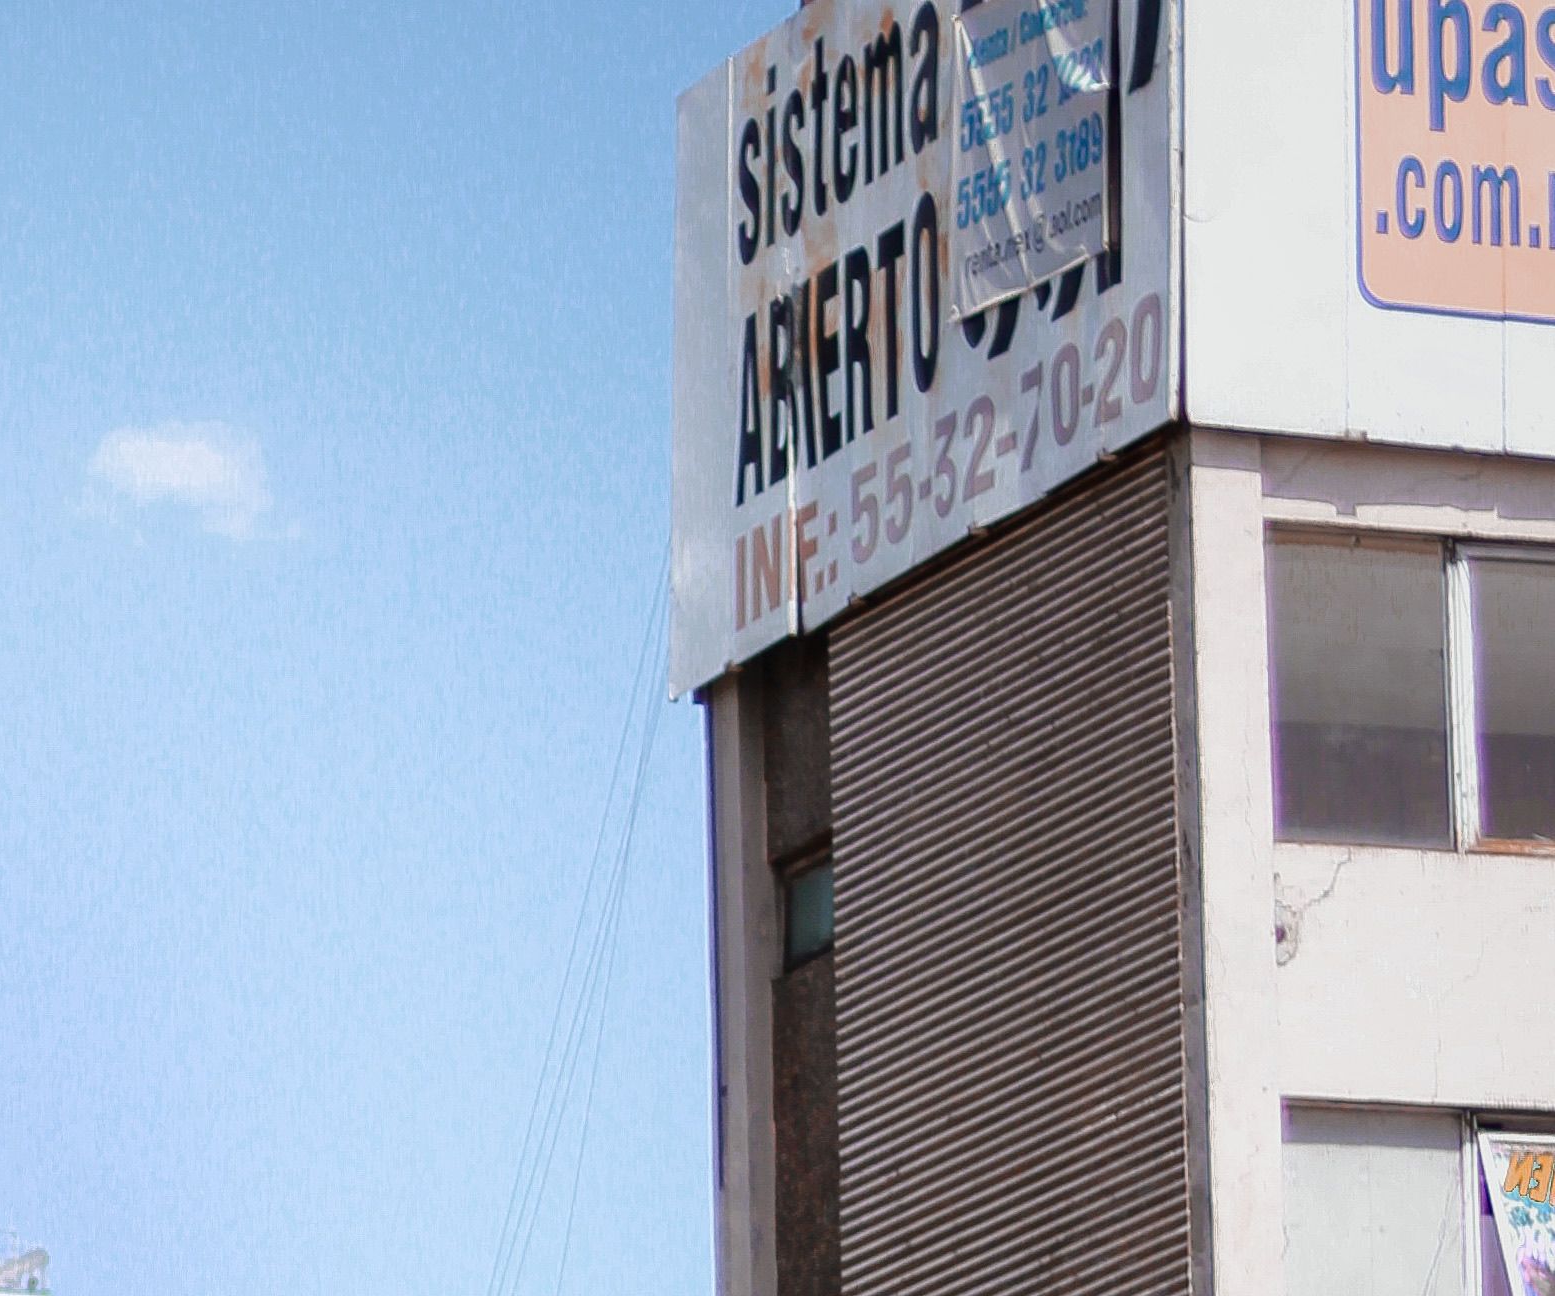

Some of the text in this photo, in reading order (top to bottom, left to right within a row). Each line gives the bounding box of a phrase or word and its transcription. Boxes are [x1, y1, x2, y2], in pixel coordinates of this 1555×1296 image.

[738, 0, 941, 266] sistema
[1020, 140, 1046, 201] 32
[1054, 111, 1103, 183] 3189
[1023, 63, 1049, 123] 32
[735, 190, 940, 507] ABIERTO
[850, 292, 1162, 564] 55-32-70-20
